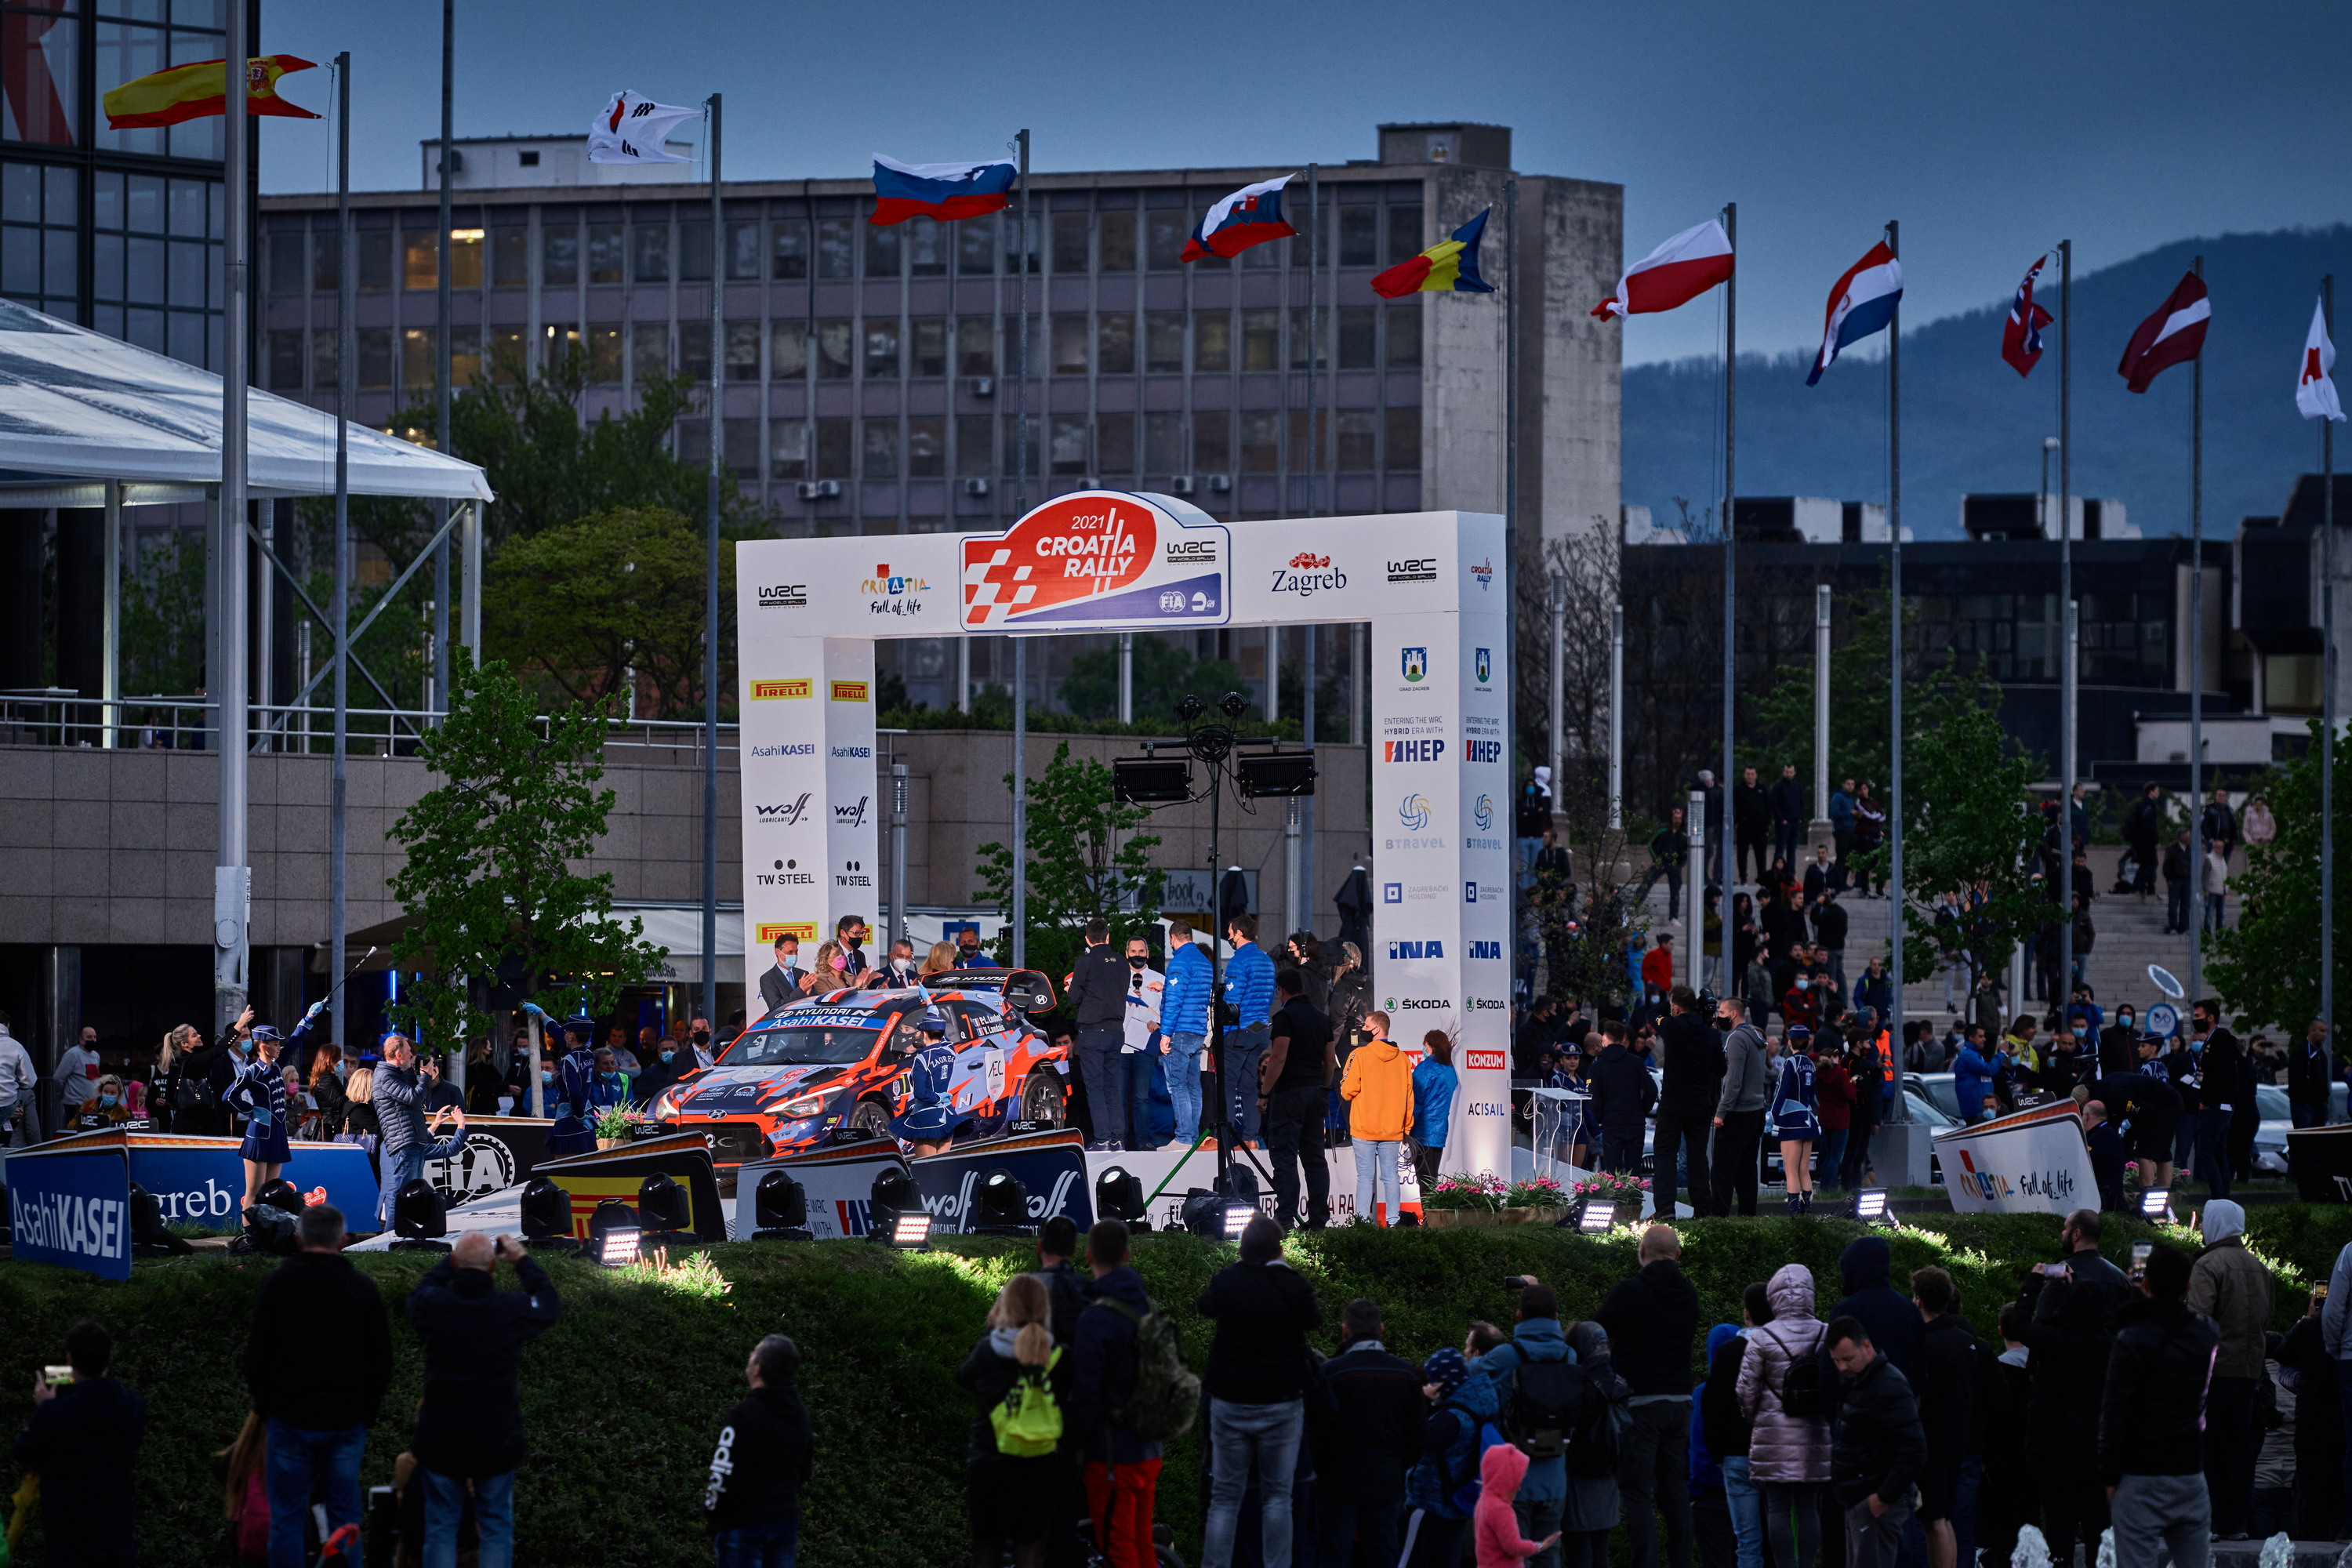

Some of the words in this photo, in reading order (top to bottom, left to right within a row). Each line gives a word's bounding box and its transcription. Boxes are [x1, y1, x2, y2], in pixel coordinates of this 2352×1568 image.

[1072, 515, 1105, 529] 2021
[1036, 521, 1136, 557] CROATIA
[1167, 541, 1216, 554] WRC
[1064, 557, 1134, 578] RALLY
[1388, 558, 1436, 572] WRC
[1471, 565, 1492, 575] CROATIA
[861, 577, 931, 595] CROATIA
[1272, 567, 1347, 597] Zagreb
[759, 585, 807, 597] WRC
[869, 599, 890, 615] Full
[892, 601, 902, 616] of
[906, 599, 922, 615] life
[756, 682, 808, 697] PIRELLI
[834, 684, 866, 699] PIRELLI
[752, 744, 815, 757] AsahiKASEI
[832, 746, 870, 758] AsahiKASEI
[1406, 740, 1445, 762] HEP
[1479, 741, 1501, 763] HEP
[757, 875, 775, 885] TW
[779, 874, 815, 884] STEEL
[836, 876, 847, 886] TW
[849, 877, 871, 887] STEEL
[1403, 999, 1450, 1009] ŠKODA
[1476, 998, 1505, 1010] ŠKODA
[768, 1016, 867, 1029] AsahiKASEI
[1468, 1052, 1504, 1068] KONZUM
[2018, 1097, 2039, 1106] WRC
[81, 1115, 98, 1126] WRC
[1012, 1121, 1036, 1131] WRC
[634, 1125, 659, 1135] WRC
[836, 1131, 858, 1140] WRC
[1959, 1171, 2015, 1200] CROATIA
[1027, 1171, 1079, 1218] olf
[811, 1200, 828, 1214] WRC
[12, 1187, 124, 1260] AsahiKASEI
[814, 1221, 833, 1236] WITH
